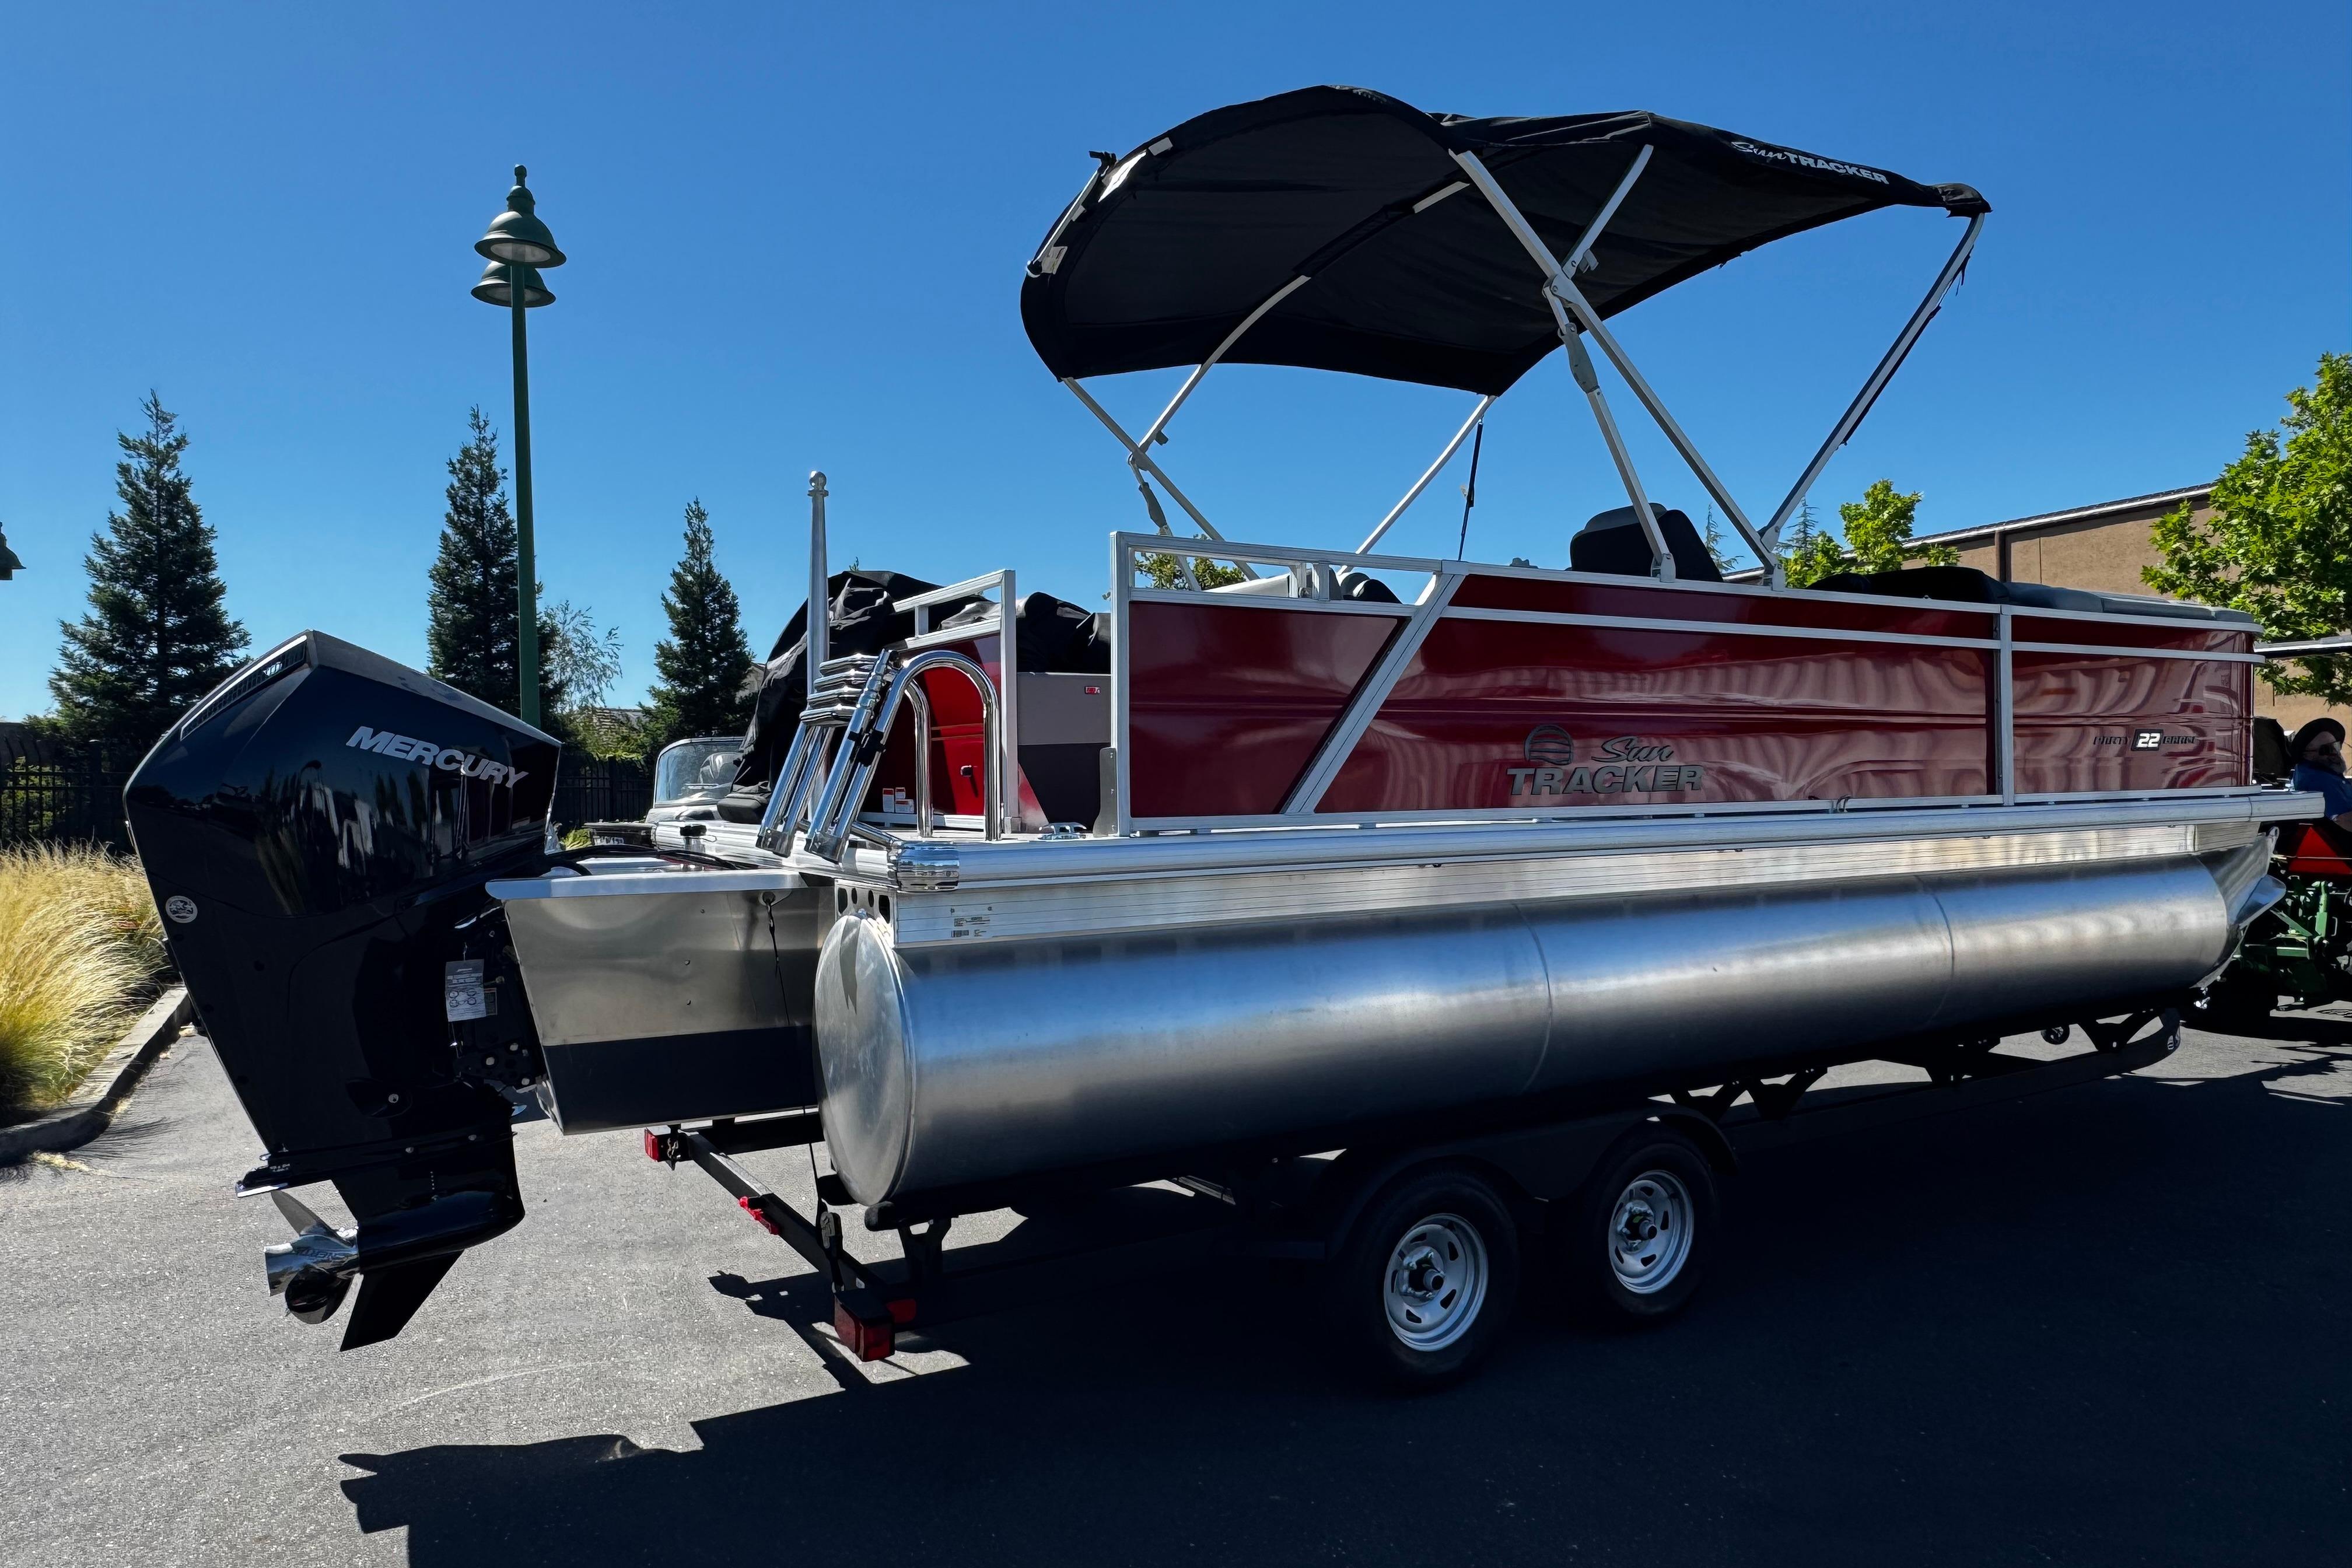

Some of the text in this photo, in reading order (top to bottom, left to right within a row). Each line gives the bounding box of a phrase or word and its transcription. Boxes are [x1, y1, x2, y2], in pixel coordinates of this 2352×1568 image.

[1591, 736, 1674, 763] Sun
[2136, 733, 2161, 748] 22
[346, 726, 529, 788] MERCURY
[1506, 764, 1704, 796] TRACKER
